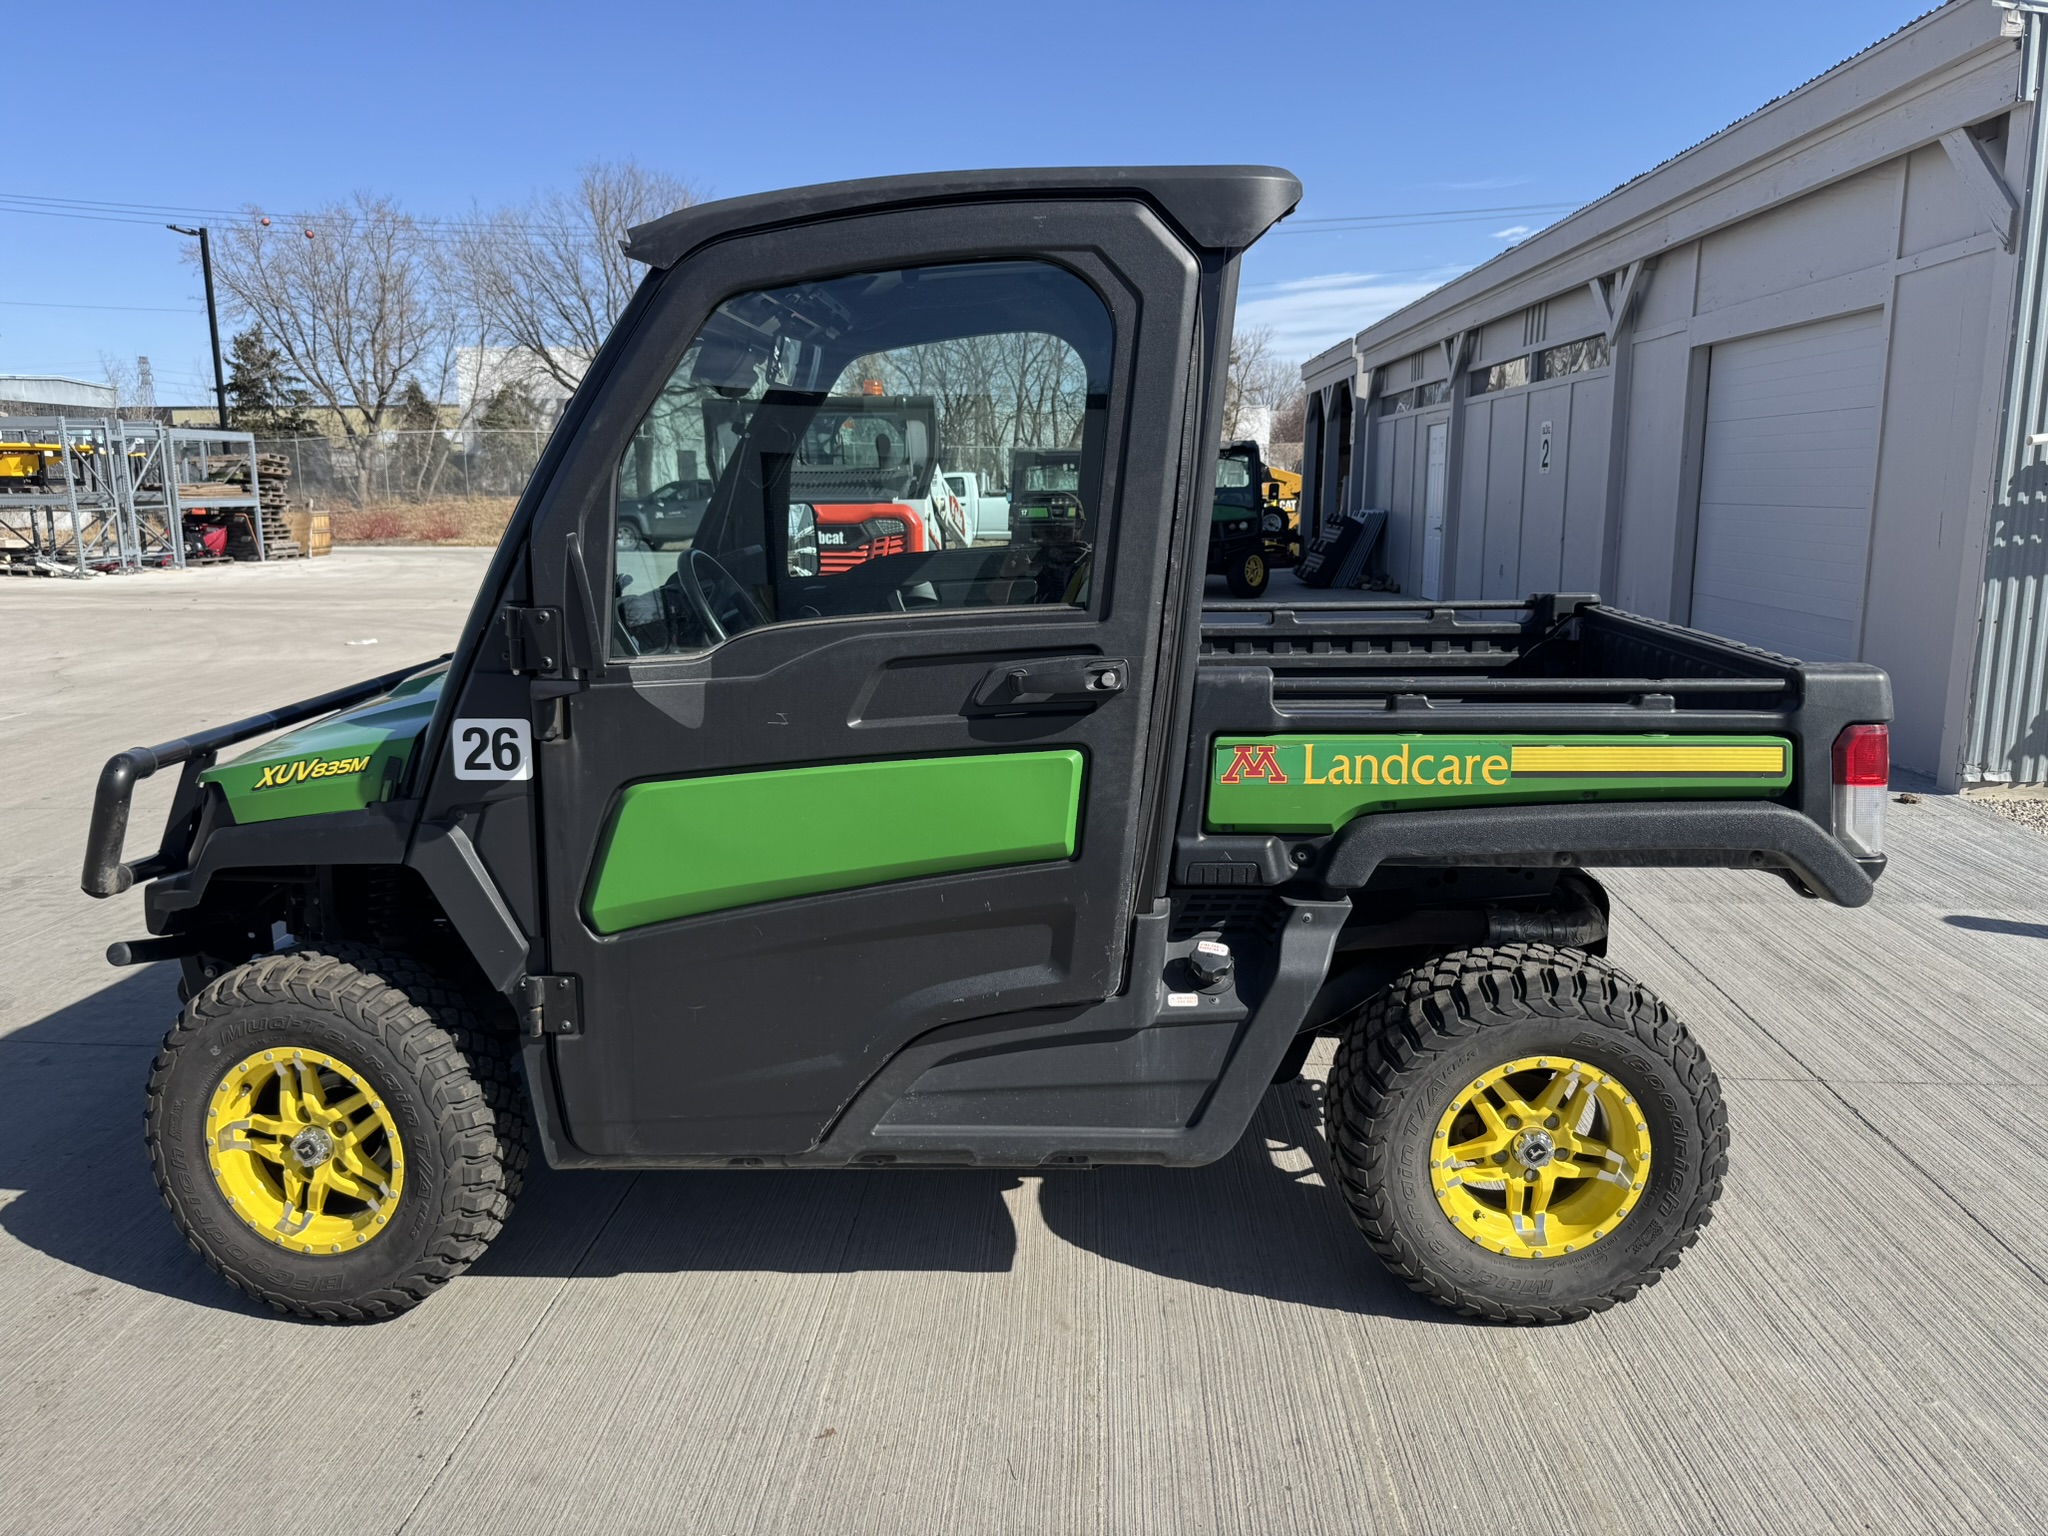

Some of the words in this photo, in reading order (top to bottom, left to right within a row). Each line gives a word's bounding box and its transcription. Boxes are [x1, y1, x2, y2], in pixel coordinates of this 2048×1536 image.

[1542, 439, 1549, 468] 2
[1279, 500, 1297, 511] CAT
[818, 531, 844, 544] bcat
[462, 727, 521, 771] 26
[1303, 743, 1509, 786] Landcare
[253, 756, 371, 790] XUV835M
[220, 1015, 419, 1127] Mud-Terrain
[1571, 1031, 1689, 1217] BFGoodrich
[172, 1147, 344, 1292] BFGoodrich
[1398, 1144, 1554, 1295] Mud-Terrain
